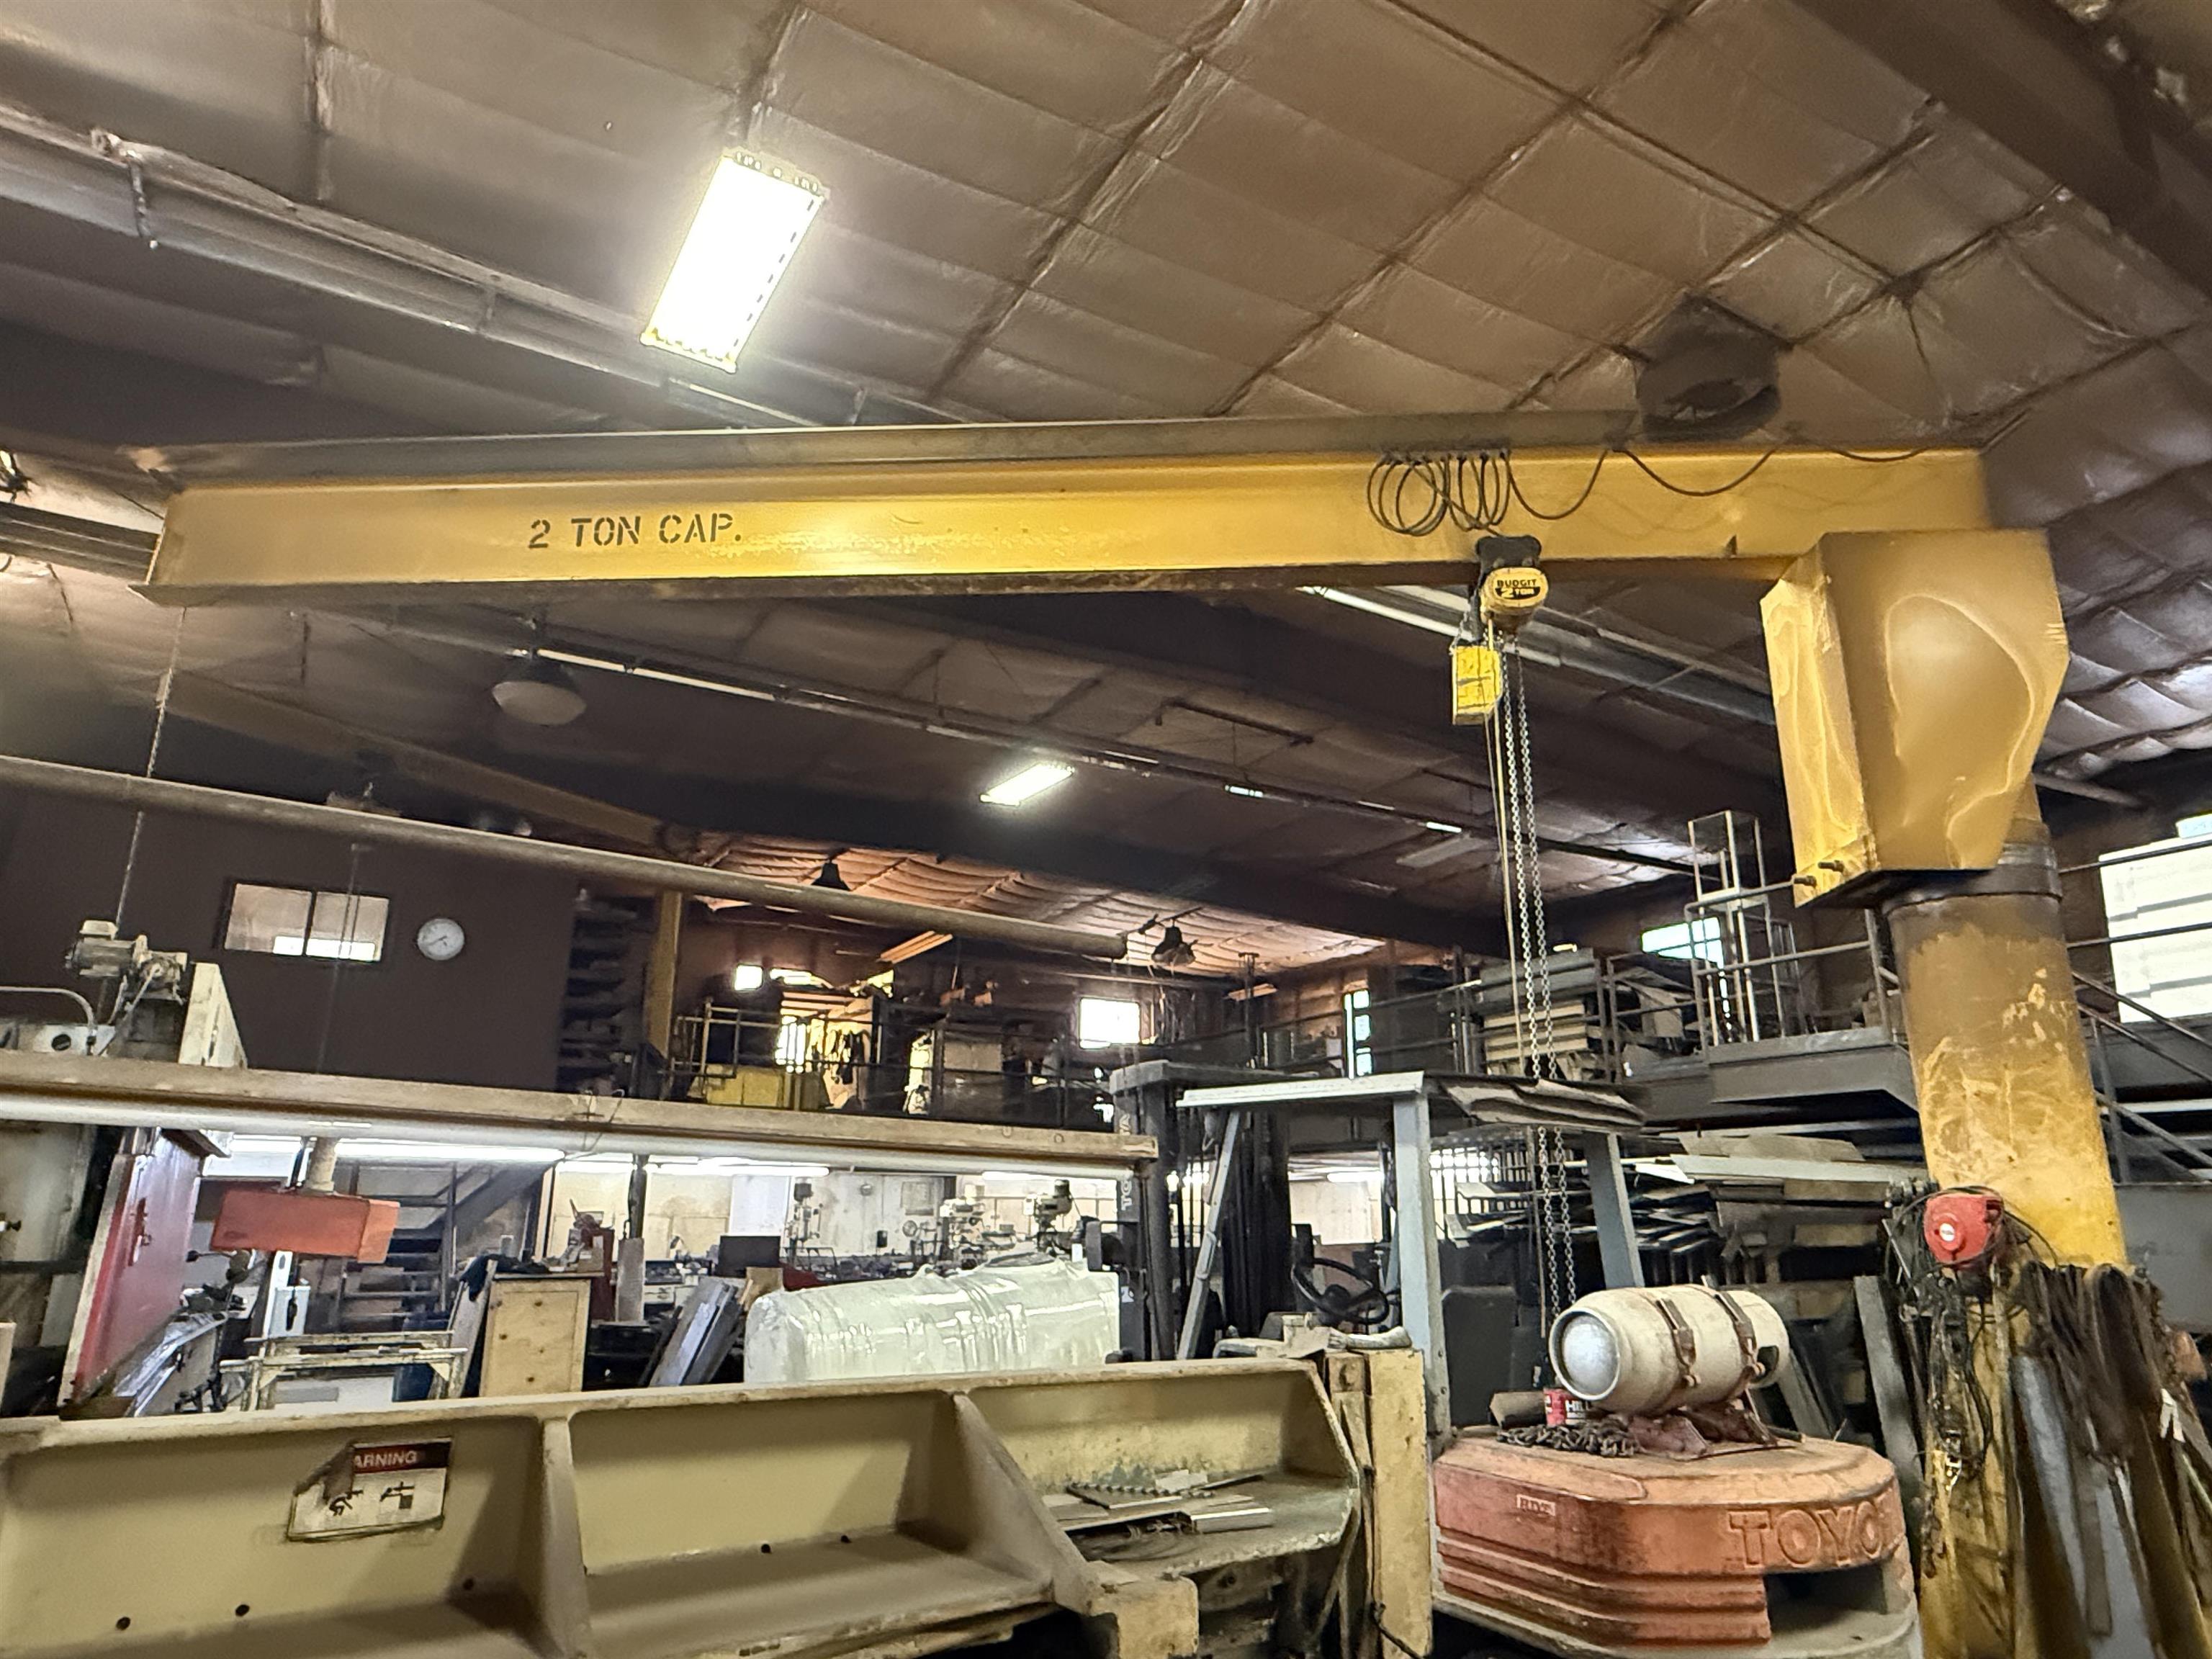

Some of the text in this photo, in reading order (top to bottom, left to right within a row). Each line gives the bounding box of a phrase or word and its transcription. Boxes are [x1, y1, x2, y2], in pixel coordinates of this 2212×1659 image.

[529, 513, 742, 549] 2 TON CAP.
[1501, 588, 1514, 598] 2
[354, 1450, 418, 1469] ARNING
